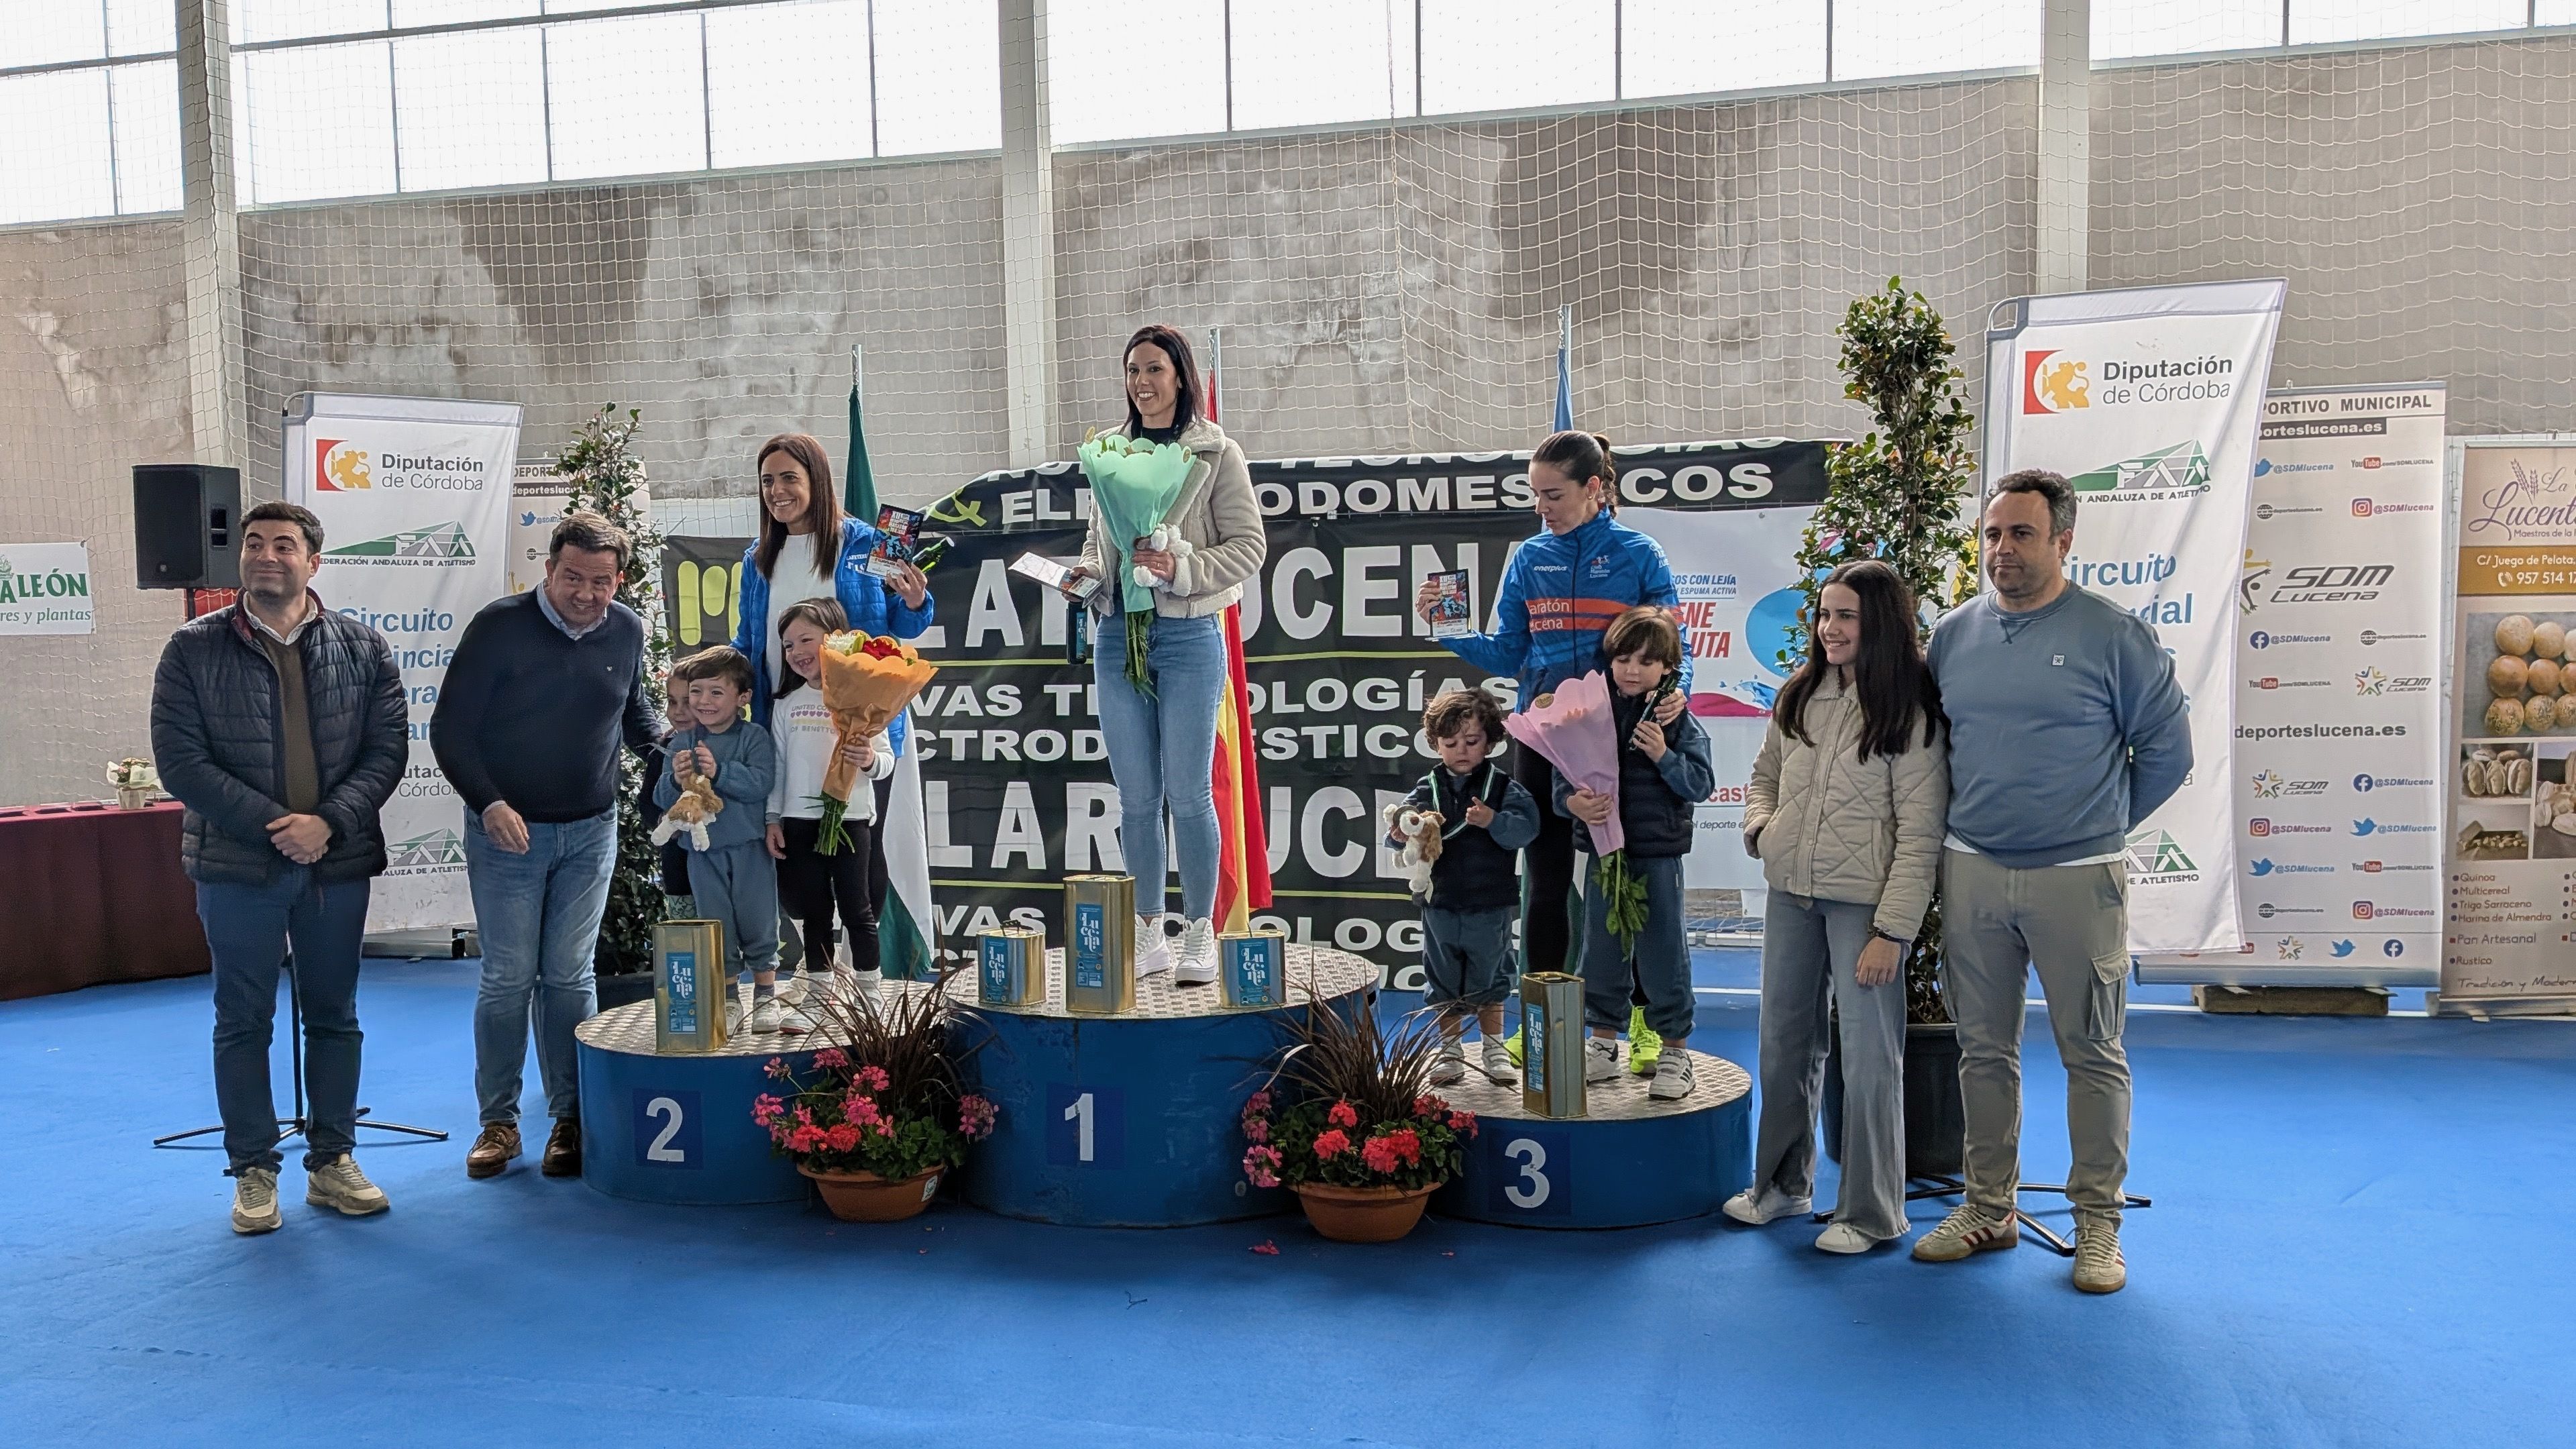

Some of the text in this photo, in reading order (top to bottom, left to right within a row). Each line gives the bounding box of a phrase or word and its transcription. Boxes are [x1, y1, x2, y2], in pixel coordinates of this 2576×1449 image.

[2104, 356, 2233, 383] Diputación
[2102, 380, 2231, 404] de Córdoba
[2341, 395, 2432, 411] MUNICIPAL
[382, 453, 483, 472] Diputación
[2273, 464, 2334, 474] @SDMlucena
[382, 473, 483, 491] de Córdoba
[2087, 493, 2146, 502] ANDALUZA
[2151, 492, 2164, 500] DE
[2373, 504, 2434, 515] @SDMlucena
[2468, 481, 2576, 541] Lucent
[2514, 528, 2550, 538] Maestros
[2552, 528, 2563, 537] de
[2564, 528, 2572, 537] la
[320, 555, 368, 566] EDERACIÓN
[372, 558, 419, 567] ANDALUZA
[423, 559, 434, 567] DE
[2477, 555, 2491, 566] C/
[2492, 555, 2524, 569] Juego
[2526, 555, 2539, 566] de
[2061, 553, 2177, 586] ircuito
[1689, 575, 1709, 585] CON
[1711, 574, 1736, 586] LEJÍA
[2279, 565, 2395, 590] SDM
[2517, 572, 2538, 585] 957
[2542, 572, 2564, 585] 514
[1680, 587, 1710, 596] ESPUMA
[1711, 587, 1737, 596] ACTIVA
[2270, 590, 2379, 603] Lucena
[1529, 598, 1570, 615] aratón
[23, 612, 32, 625] y
[36, 607, 91, 625] plantas
[2391, 677, 2432, 686] SDM
[910, 684, 1022, 716] VAS
[802, 725, 836, 734] BENETTO
[2235, 724, 2407, 741] deporteslucena.es
[2286, 780, 2329, 790] SDM
[926, 781, 1126, 871] LAR
[1699, 820, 1737, 830] deporte
[383, 869, 412, 877] ALUZA
[431, 865, 468, 874] ATLETIS
[2460, 873, 2496, 882] Quinoa
[2141, 873, 2200, 885] ATLETISMO
[2460, 885, 2510, 896] Multicereal
[2459, 900, 2532, 912] Trigo Sarraceno
[932, 904, 1046, 936] VAS
[2457, 912, 2552, 923] Harina de Almendra
[2457, 932, 2536, 945] Pan Artesanal
[2519, 982, 2526, 991] y
[647, 1097, 685, 1162] 2
[1064, 1093, 1094, 1162] 1
[1504, 1138, 1550, 1208] 3
